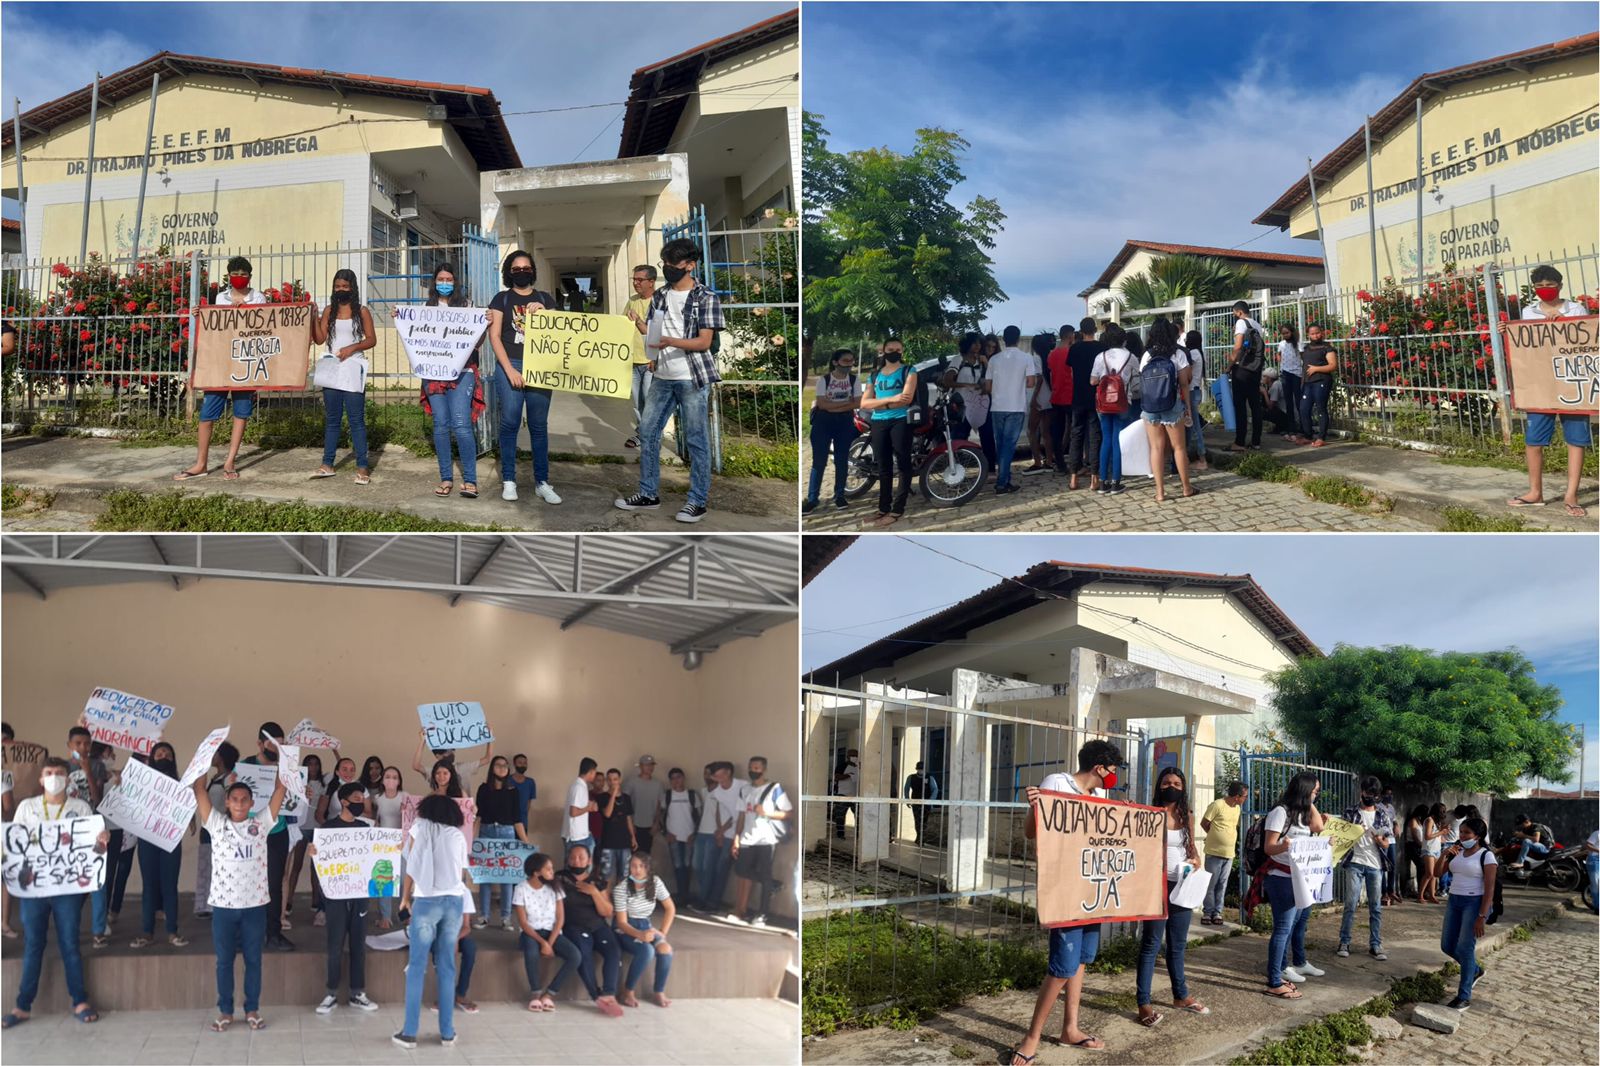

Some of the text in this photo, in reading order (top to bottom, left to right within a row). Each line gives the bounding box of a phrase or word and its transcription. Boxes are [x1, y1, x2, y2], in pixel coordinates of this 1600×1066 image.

[67, 161, 87, 176] DR.
[93, 155, 156, 173] TRAJANO
[162, 148, 206, 166] PIRES
[214, 145, 234, 161] DA
[1350, 197, 1367, 212] DR.
[1373, 176, 1426, 203] RAJANO
[1432, 158, 1477, 184] PIRES
[1484, 145, 1508, 166] DA
[162, 211, 219, 229] GOVERNO
[1440, 218, 1499, 245] GOVERNO
[161, 232, 174, 247] DA
[1441, 247, 1456, 263] DA
[200, 308, 264, 331] VOLTAMOS
[267, 309, 277, 329] A
[419, 308, 433, 321] AO
[436, 309, 469, 324] DESCASO
[530, 314, 599, 335] EDUCAÇÃO
[238, 330, 273, 338] QUEREMOS
[1507, 321, 1590, 348] VOLTAMOS
[231, 338, 281, 359] ENERGIA
[530, 335, 630, 361] NÃO É GASTO
[231, 356, 270, 382] JÁ
[525, 370, 618, 394] INVESTIMENTO
[874, 379, 903, 391] ILA
[433, 702, 469, 720] LUTO
[426, 722, 491, 748] EDUCAÇÃO
[1039, 797, 1118, 836] VOLTAMOS
[1120, 810, 1132, 838] A
[6, 818, 94, 856] QUE
[318, 832, 350, 846] SOMOS
[1088, 837, 1128, 847] QUEREMOS
[319, 844, 369, 861] QUEREMOS
[1081, 849, 1136, 877] ENERGIA
[1082, 875, 1122, 911] JÁ
